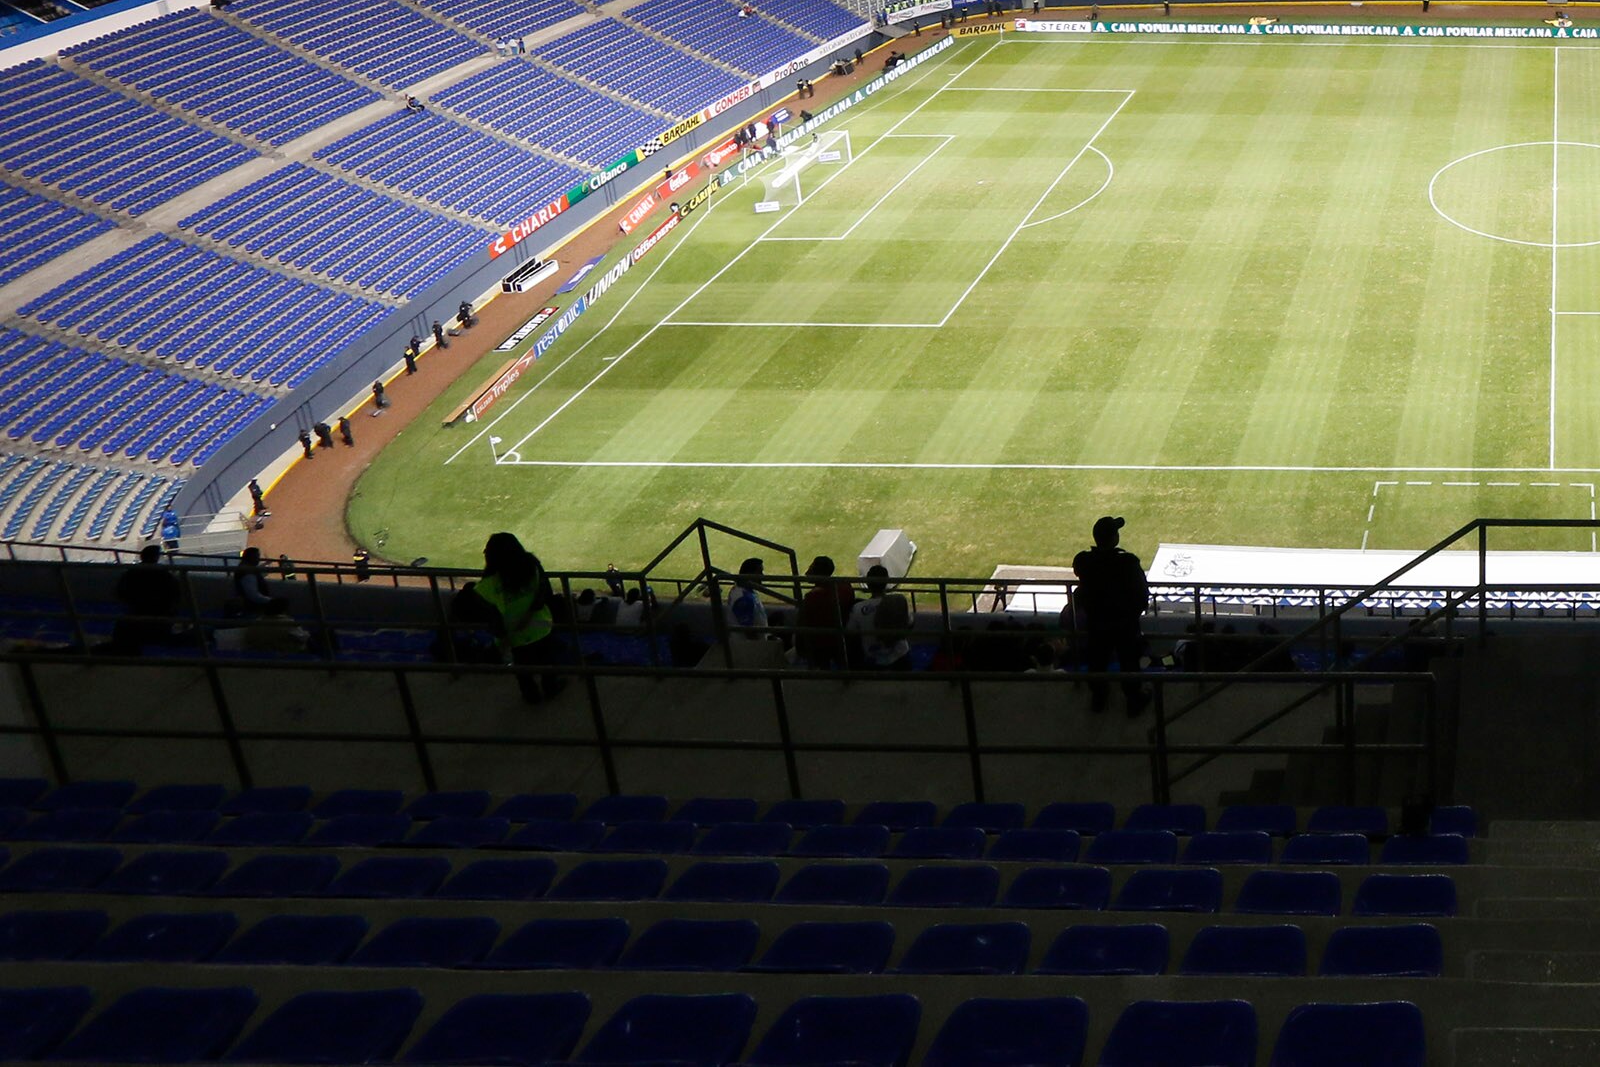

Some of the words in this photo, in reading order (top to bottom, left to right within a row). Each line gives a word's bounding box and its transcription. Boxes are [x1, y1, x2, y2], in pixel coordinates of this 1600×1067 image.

[959, 23, 1007, 35] BARDAHL
[1041, 22, 1086, 31] STEREN
[1138, 23, 1187, 33] POPULAR
[1188, 23, 1245, 34] MEXICANA
[1293, 25, 1339, 35] POPULAR
[1341, 26, 1398, 36] MEXICANA
[1446, 26, 1493, 37] POPULAR
[1495, 27, 1552, 38] MEXICANA
[885, 59, 918, 84] POPULAR
[916, 35, 954, 69] MEXICANA
[714, 86, 751, 114] GONHER
[805, 97, 853, 130] MEXICANA
[663, 114, 700, 143] BARDAHL
[511, 198, 564, 244] CHARLY
[629, 194, 655, 224] CHARLY
[633, 237, 657, 259] Office
[492, 369, 520, 398] Triples
